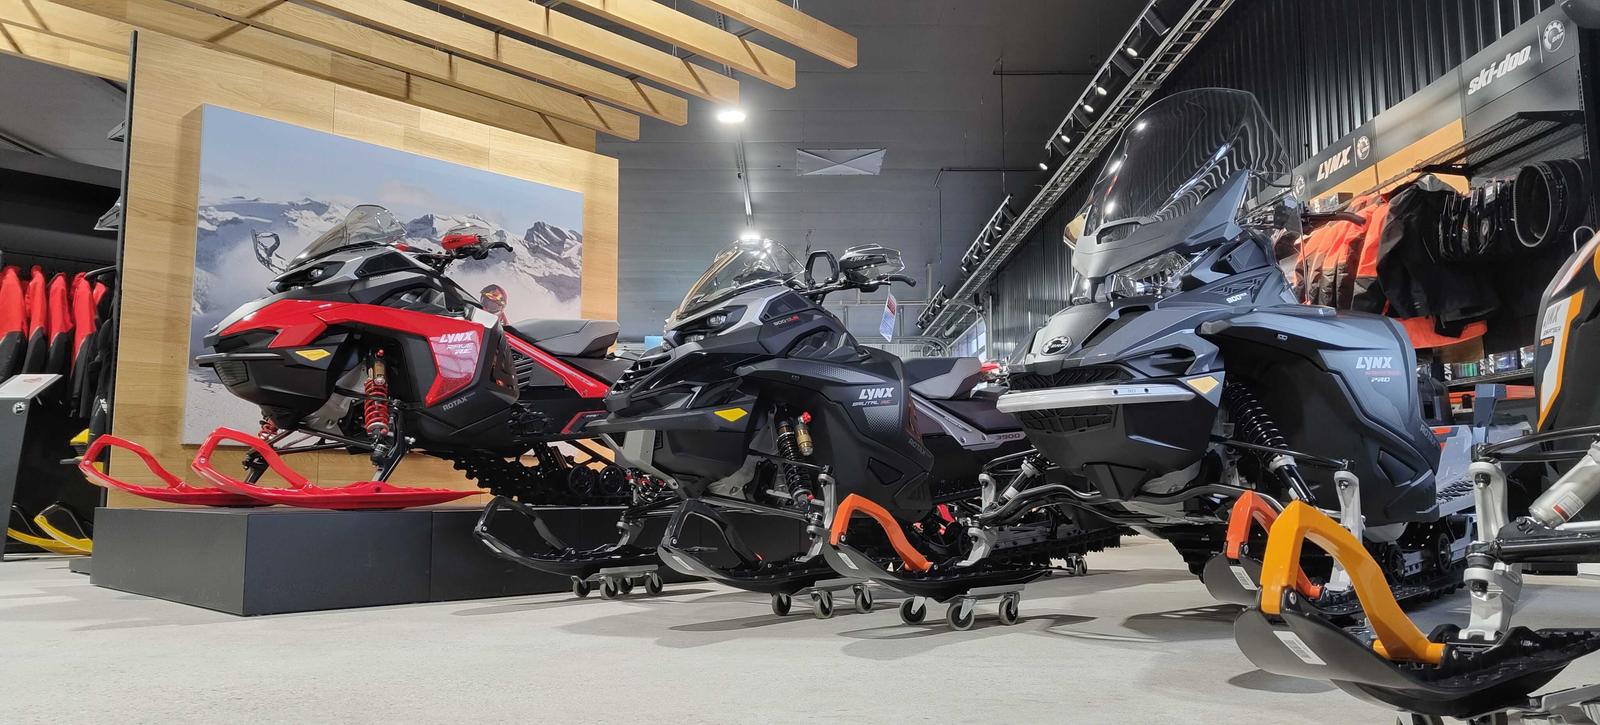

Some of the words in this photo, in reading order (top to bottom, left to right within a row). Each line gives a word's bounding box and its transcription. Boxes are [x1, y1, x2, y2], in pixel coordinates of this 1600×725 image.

[1316, 145, 1352, 183] LYNX
[440, 330, 474, 343] LYNX
[1355, 356, 1392, 370] LYNX
[858, 387, 894, 400] LYNX
[442, 396, 467, 411] ROTAX
